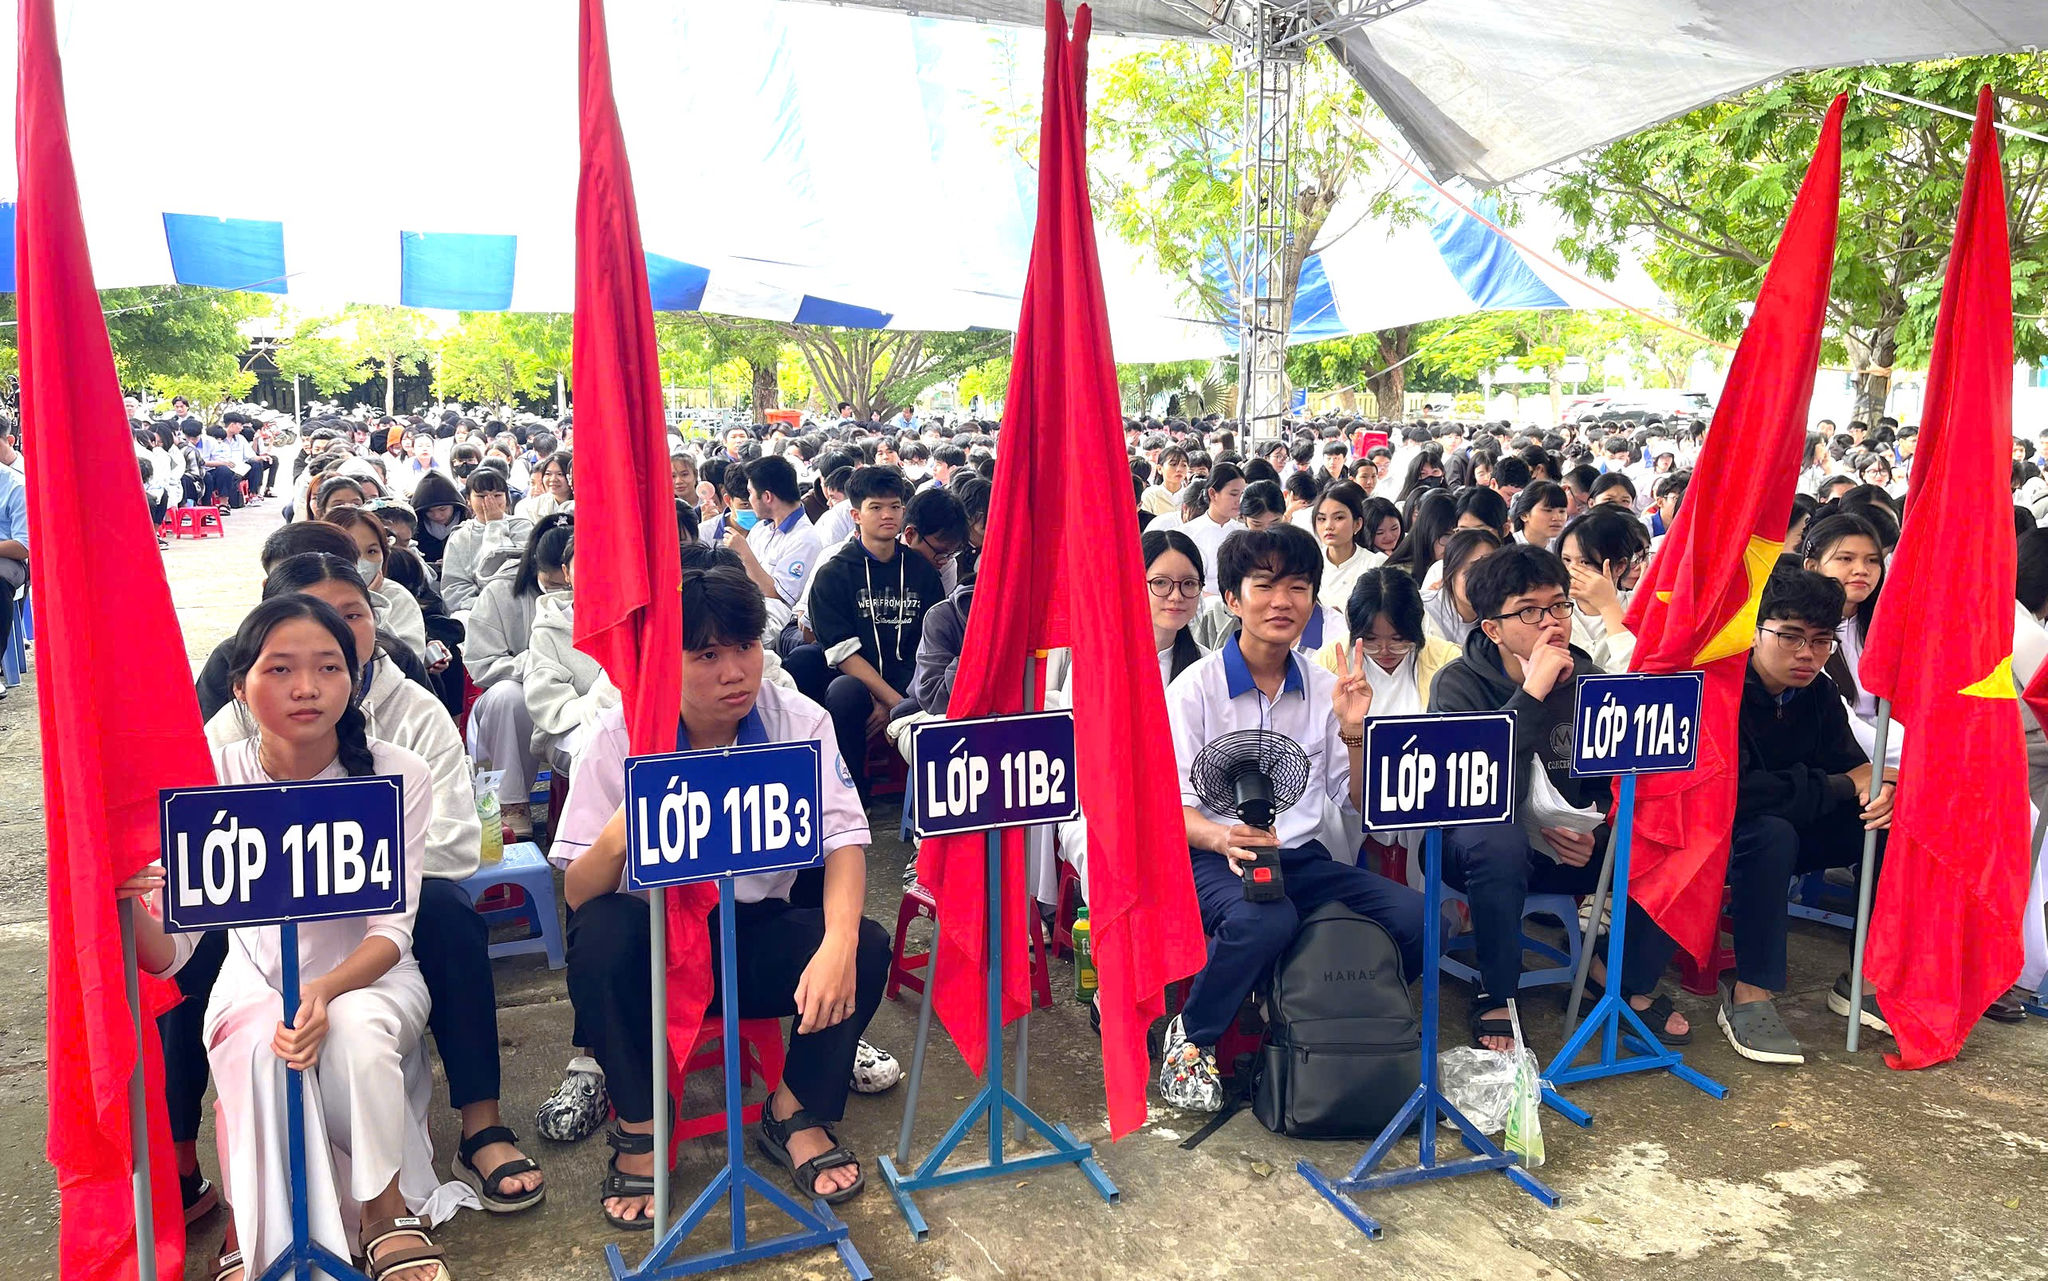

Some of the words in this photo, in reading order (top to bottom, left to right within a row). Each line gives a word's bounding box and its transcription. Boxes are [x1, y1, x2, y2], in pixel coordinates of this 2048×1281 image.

[880, 599, 901, 608] FROM
[1581, 697, 1628, 760] LỚP
[1633, 703, 1691, 757] 11A3
[927, 735, 989, 819] LỚP
[1000, 748, 1067, 810] 11B2
[1380, 734, 1437, 813] LỚP
[1446, 750, 1498, 808] 11B1
[177, 809, 268, 907] LỚP
[282, 820, 392, 899] 11B4
[638, 775, 711, 866] LỚP
[723, 782, 813, 856] 11B3
